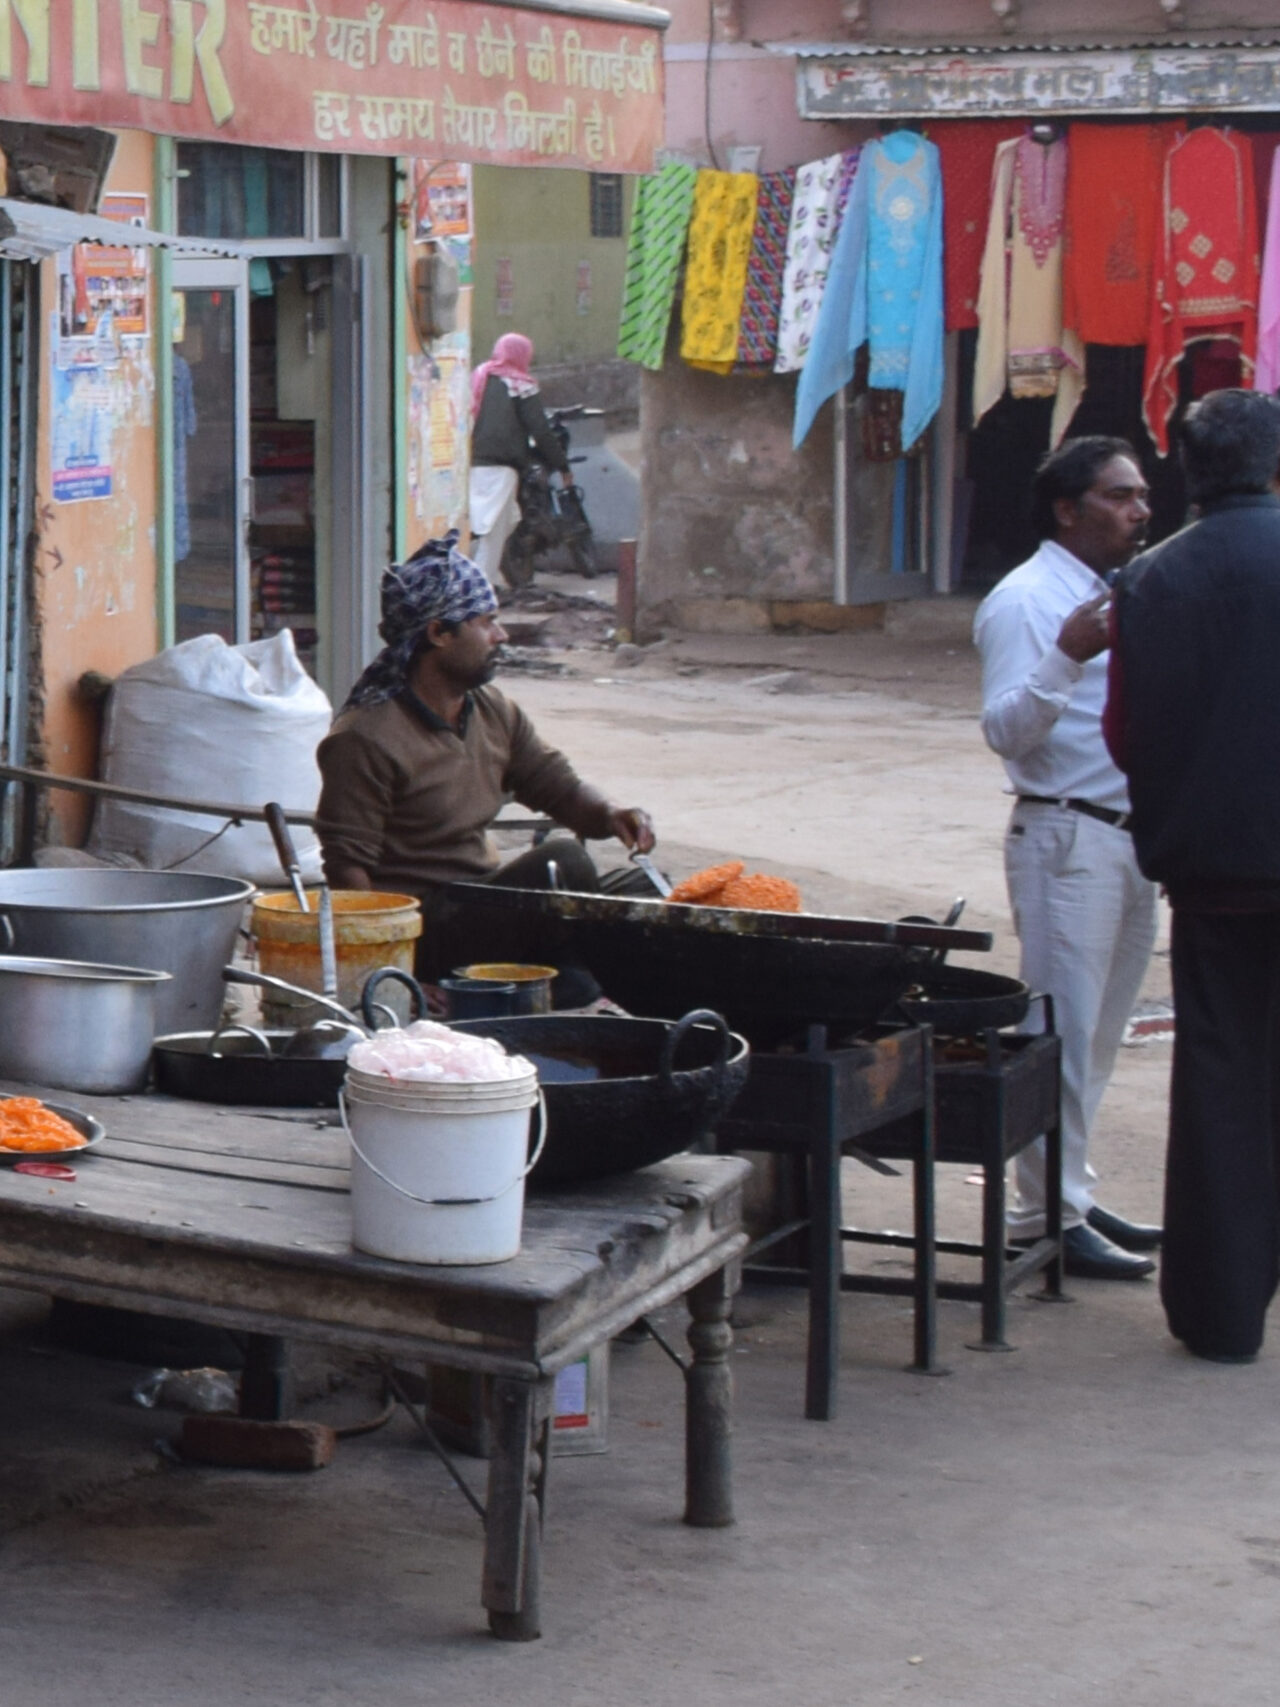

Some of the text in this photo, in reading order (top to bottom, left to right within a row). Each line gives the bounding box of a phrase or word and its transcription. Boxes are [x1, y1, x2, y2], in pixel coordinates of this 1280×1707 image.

[247, 0, 320, 58] हमारे
[447, 32, 467, 74] व
[525, 24, 557, 84] की
[312, 90, 352, 141] हर
[356, 95, 435, 141] समय
[440, 84, 498, 150] तैयार
[504, 90, 577, 155] मिलती
